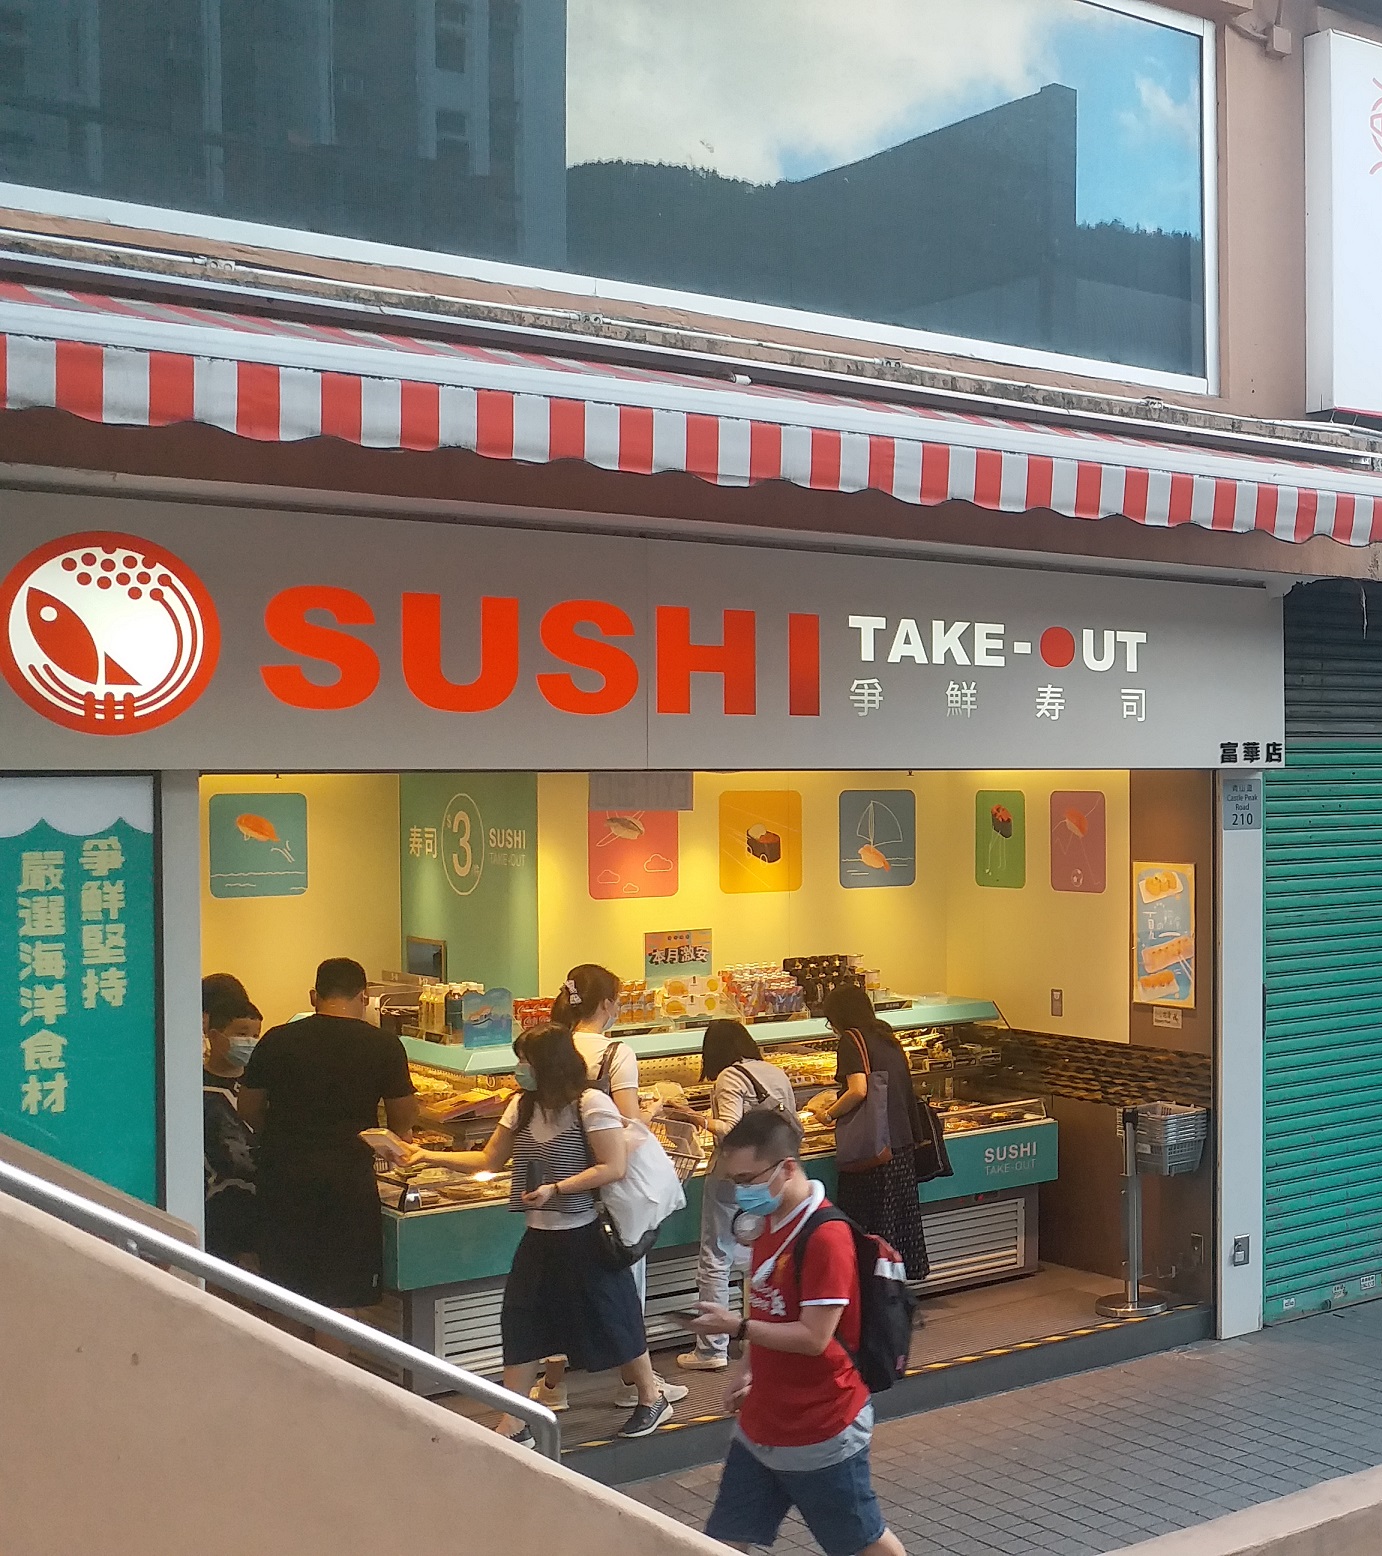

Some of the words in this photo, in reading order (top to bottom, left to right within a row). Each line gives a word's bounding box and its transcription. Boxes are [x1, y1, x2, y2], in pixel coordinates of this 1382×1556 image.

[259, 584, 820, 716] SUSHI
[848, 615, 1147, 672] TAKE-OUT
[1219, 742, 1283, 763] 富華店
[1235, 803, 1250, 811] Road
[1232, 813, 1253, 826] 210
[409, 825, 438, 859] 寿司
[489, 828, 526, 850] SUSHI
[17, 851, 68, 1115] 嚴選海洋食材
[984, 1141, 1037, 1163] SUSHI
[984, 1158, 1036, 1176] TAKE-OUT
